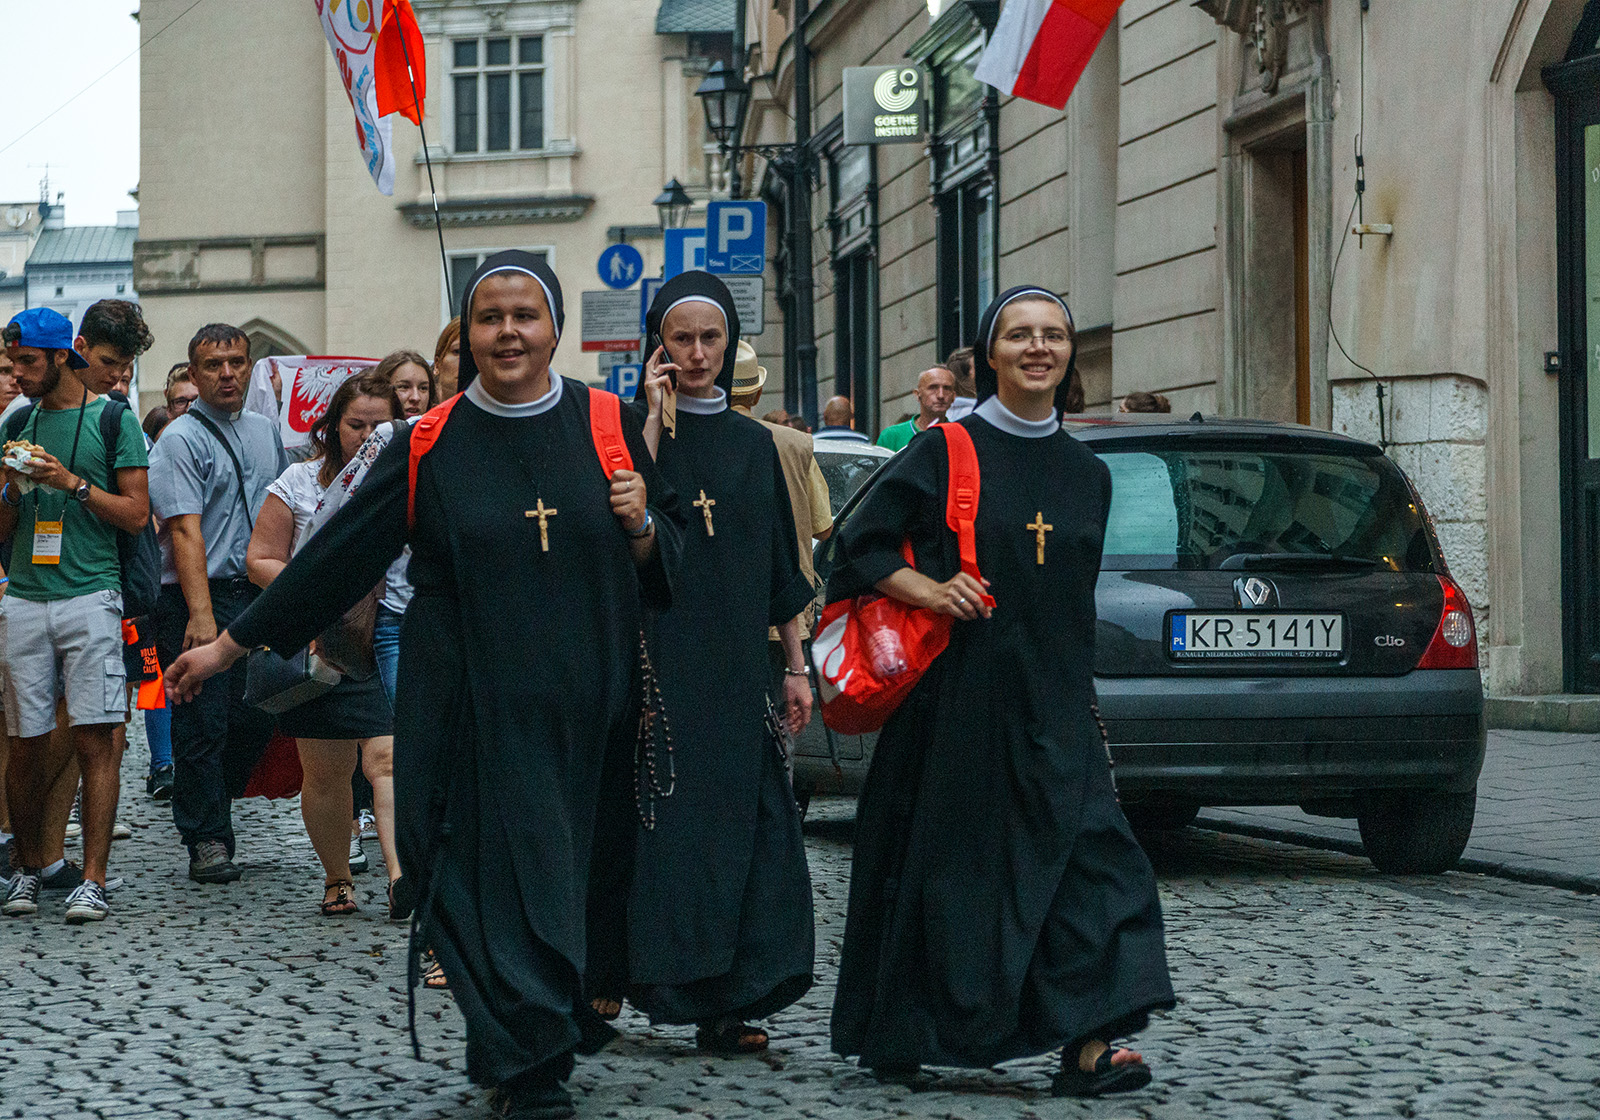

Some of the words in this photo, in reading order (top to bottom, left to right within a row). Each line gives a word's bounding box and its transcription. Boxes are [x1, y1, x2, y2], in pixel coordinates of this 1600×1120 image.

[874, 114, 919, 127] GOETHE
[874, 126, 919, 137] INSTITUT
[718, 207, 753, 253] P
[618, 367, 639, 395] P
[1191, 618, 1234, 647] KR
[1245, 618, 1337, 647] 5141Y
[1173, 637, 1185, 645] PL
[1373, 634, 1406, 647] Clio
